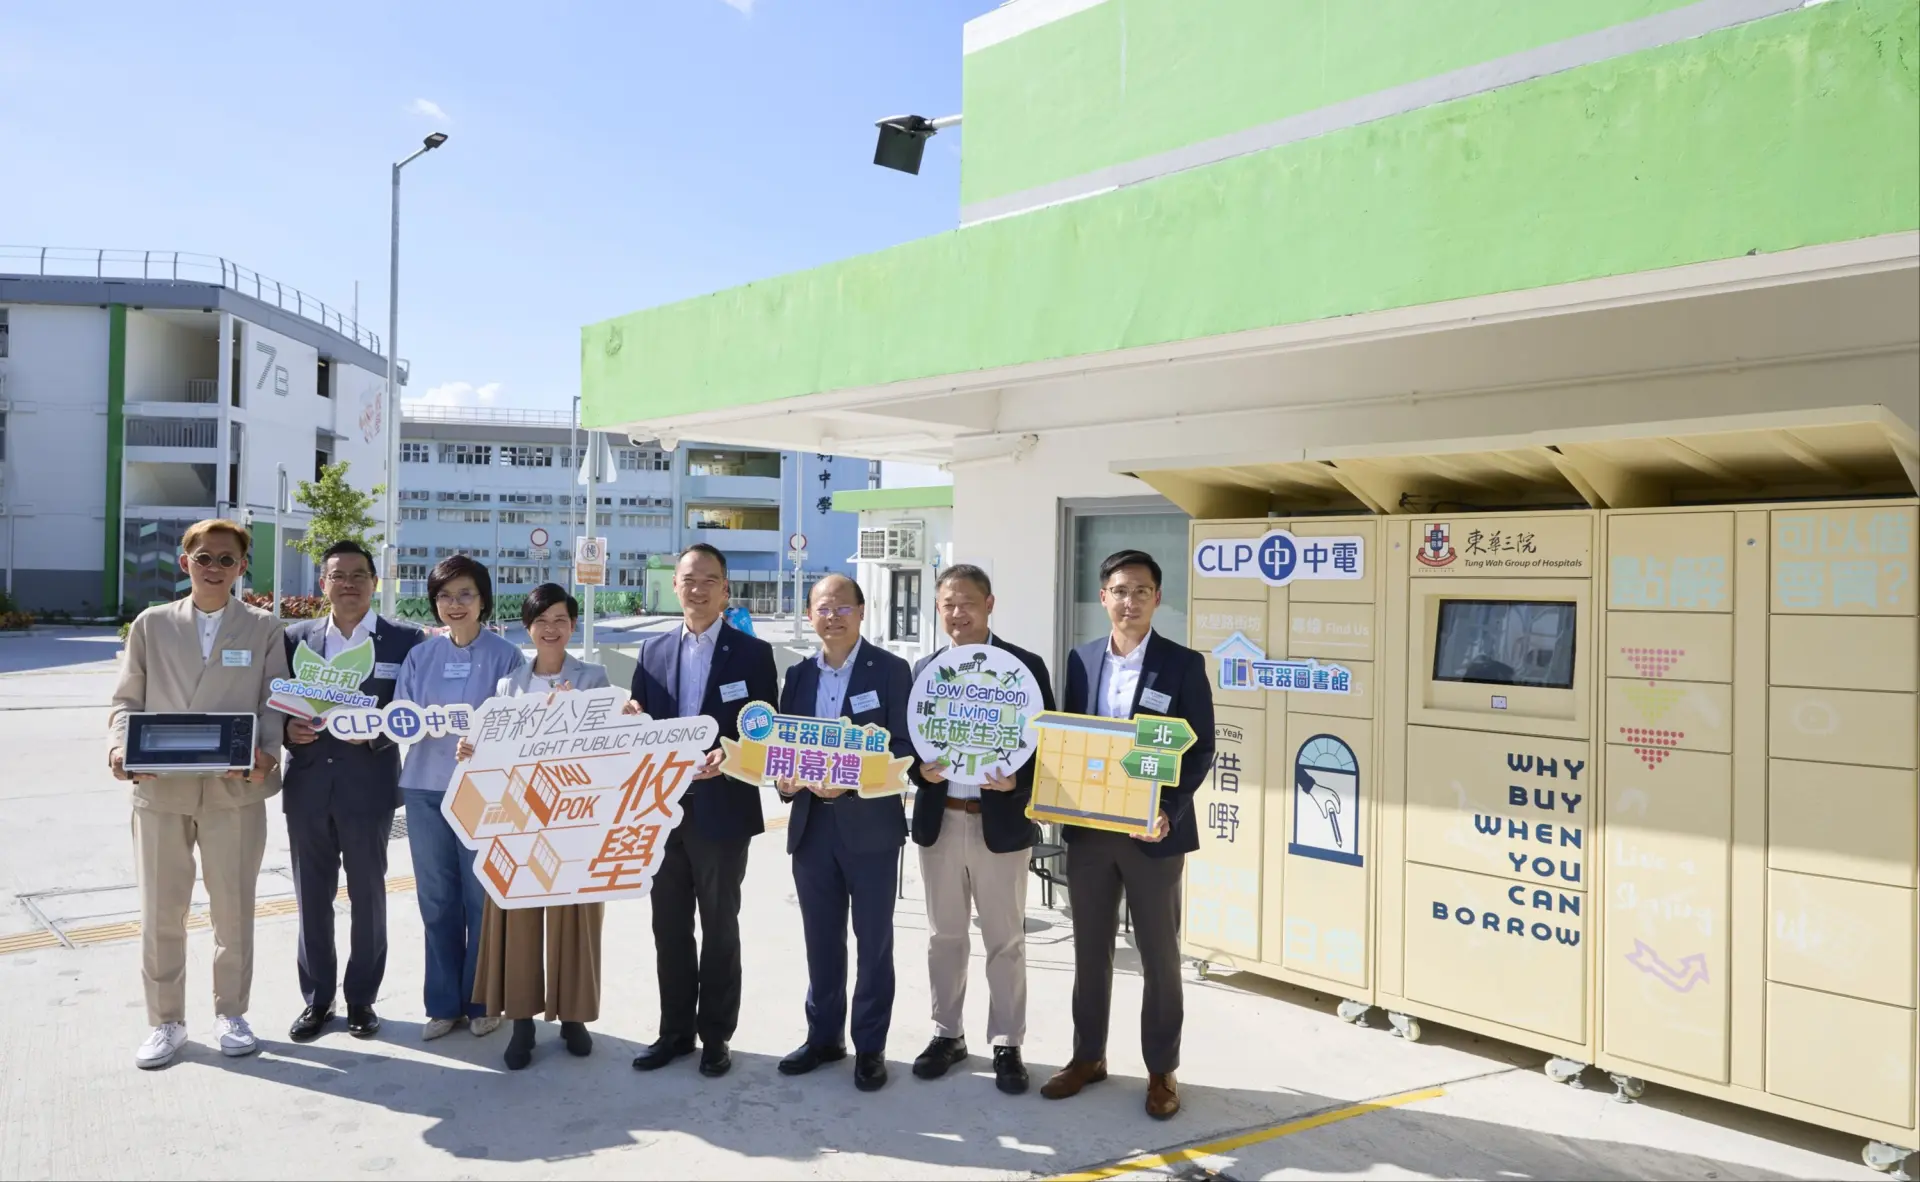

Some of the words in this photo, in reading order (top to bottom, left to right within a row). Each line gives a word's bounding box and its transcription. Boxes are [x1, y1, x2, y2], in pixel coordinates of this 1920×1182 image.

[256, 341, 289, 397] 7B
[1465, 528, 1537, 556] 東華三院
[1198, 545, 1253, 572] CLP
[1303, 543, 1357, 573] 中電
[1465, 559, 1484, 569] Tung
[1485, 559, 1503, 567] Wah
[1505, 559, 1530, 569] Group
[1532, 559, 1541, 567] of
[1543, 558, 1582, 569] Hospitals
[299, 664, 362, 690] 碳中和
[1257, 667, 1349, 691] 電器圖書館
[271, 680, 322, 699] Carbon
[324, 691, 376, 708] Neutral
[926, 680, 962, 697] Low
[966, 684, 1026, 703] Carbon
[333, 714, 382, 735] CLP
[425, 710, 470, 732] 中電
[482, 697, 615, 743] 簡約公屋
[948, 702, 1000, 722] Living
[519, 739, 566, 758] LIGHT
[571, 733, 630, 753] PUBLIC
[633, 725, 708, 747] HOUSING
[778, 721, 887, 753] 電器圖書館
[924, 717, 1019, 749] 低碳生活
[1152, 724, 1173, 745] 北
[1223, 728, 1243, 740] Yeah
[546, 763, 592, 787] YAU
[766, 745, 861, 786] 開幕禮
[1140, 755, 1159, 776] 南
[1507, 753, 1585, 780] WHY
[553, 795, 601, 821] POK
[1209, 751, 1241, 843] 借嘢
[1509, 785, 1582, 814] BUY
[578, 751, 695, 893] 攸壆
[1474, 814, 1582, 850] WHEN
[1508, 852, 1581, 883] YOU
[1508, 885, 1580, 917] CAN
[1432, 901, 1580, 946] BORROW
